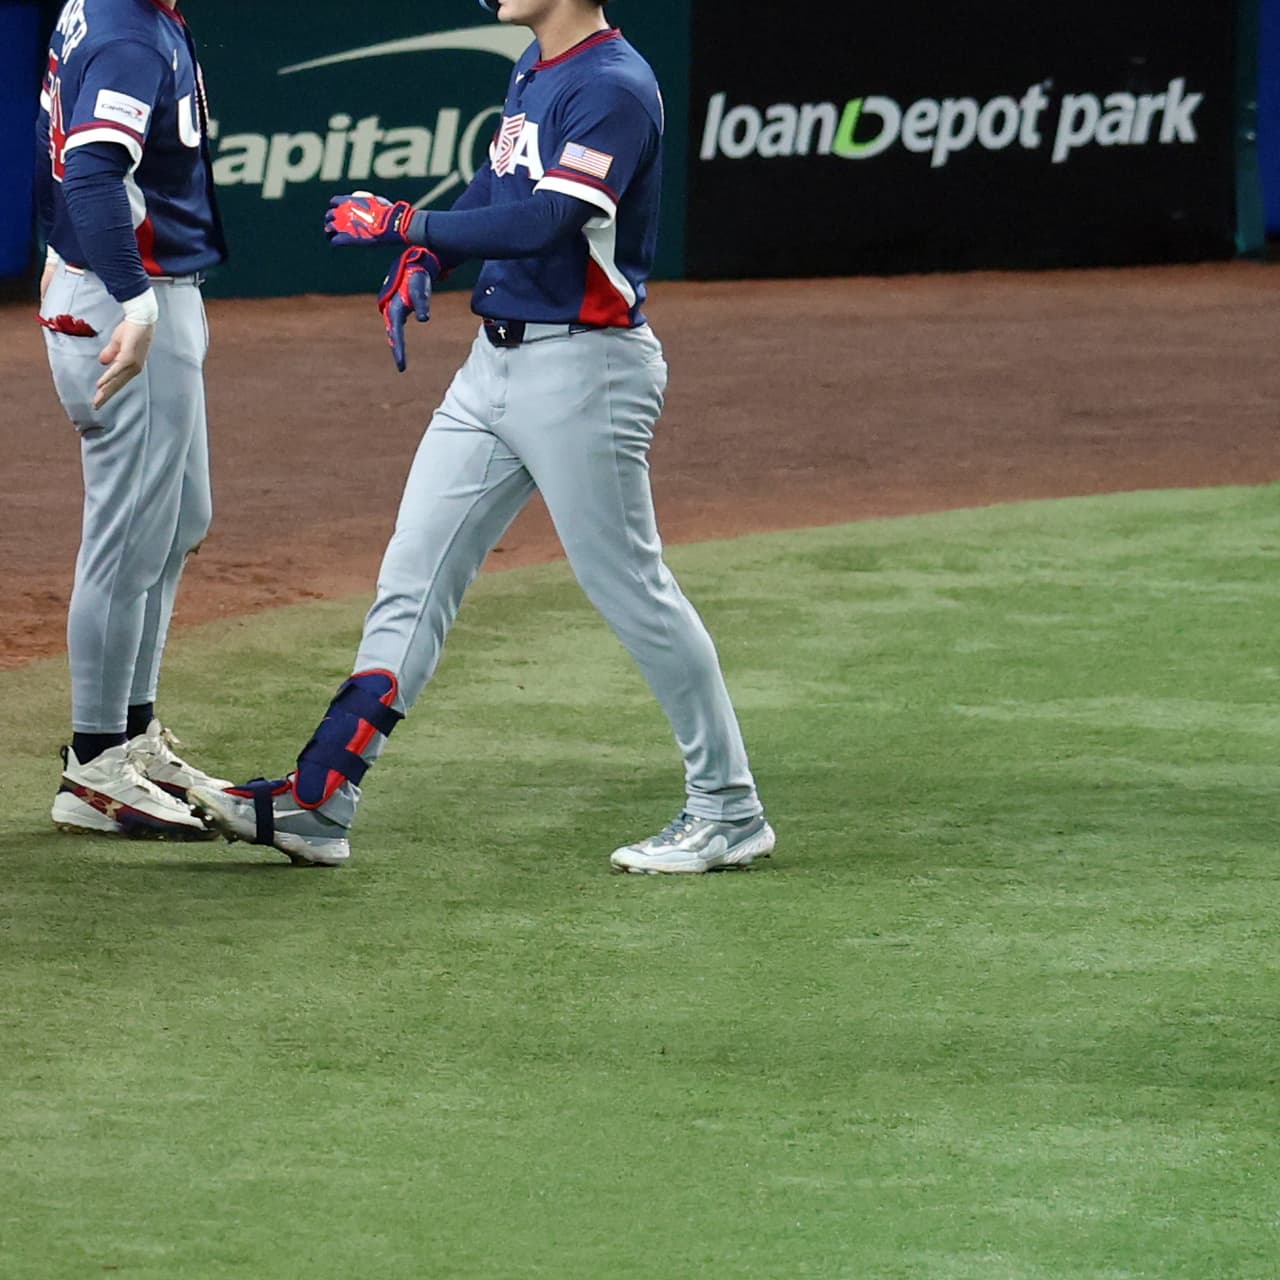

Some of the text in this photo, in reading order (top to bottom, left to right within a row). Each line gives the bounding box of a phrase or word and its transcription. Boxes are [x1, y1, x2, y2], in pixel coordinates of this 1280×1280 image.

[209, 107, 460, 200] apital
[700, 77, 1204, 168] loanDepot park
